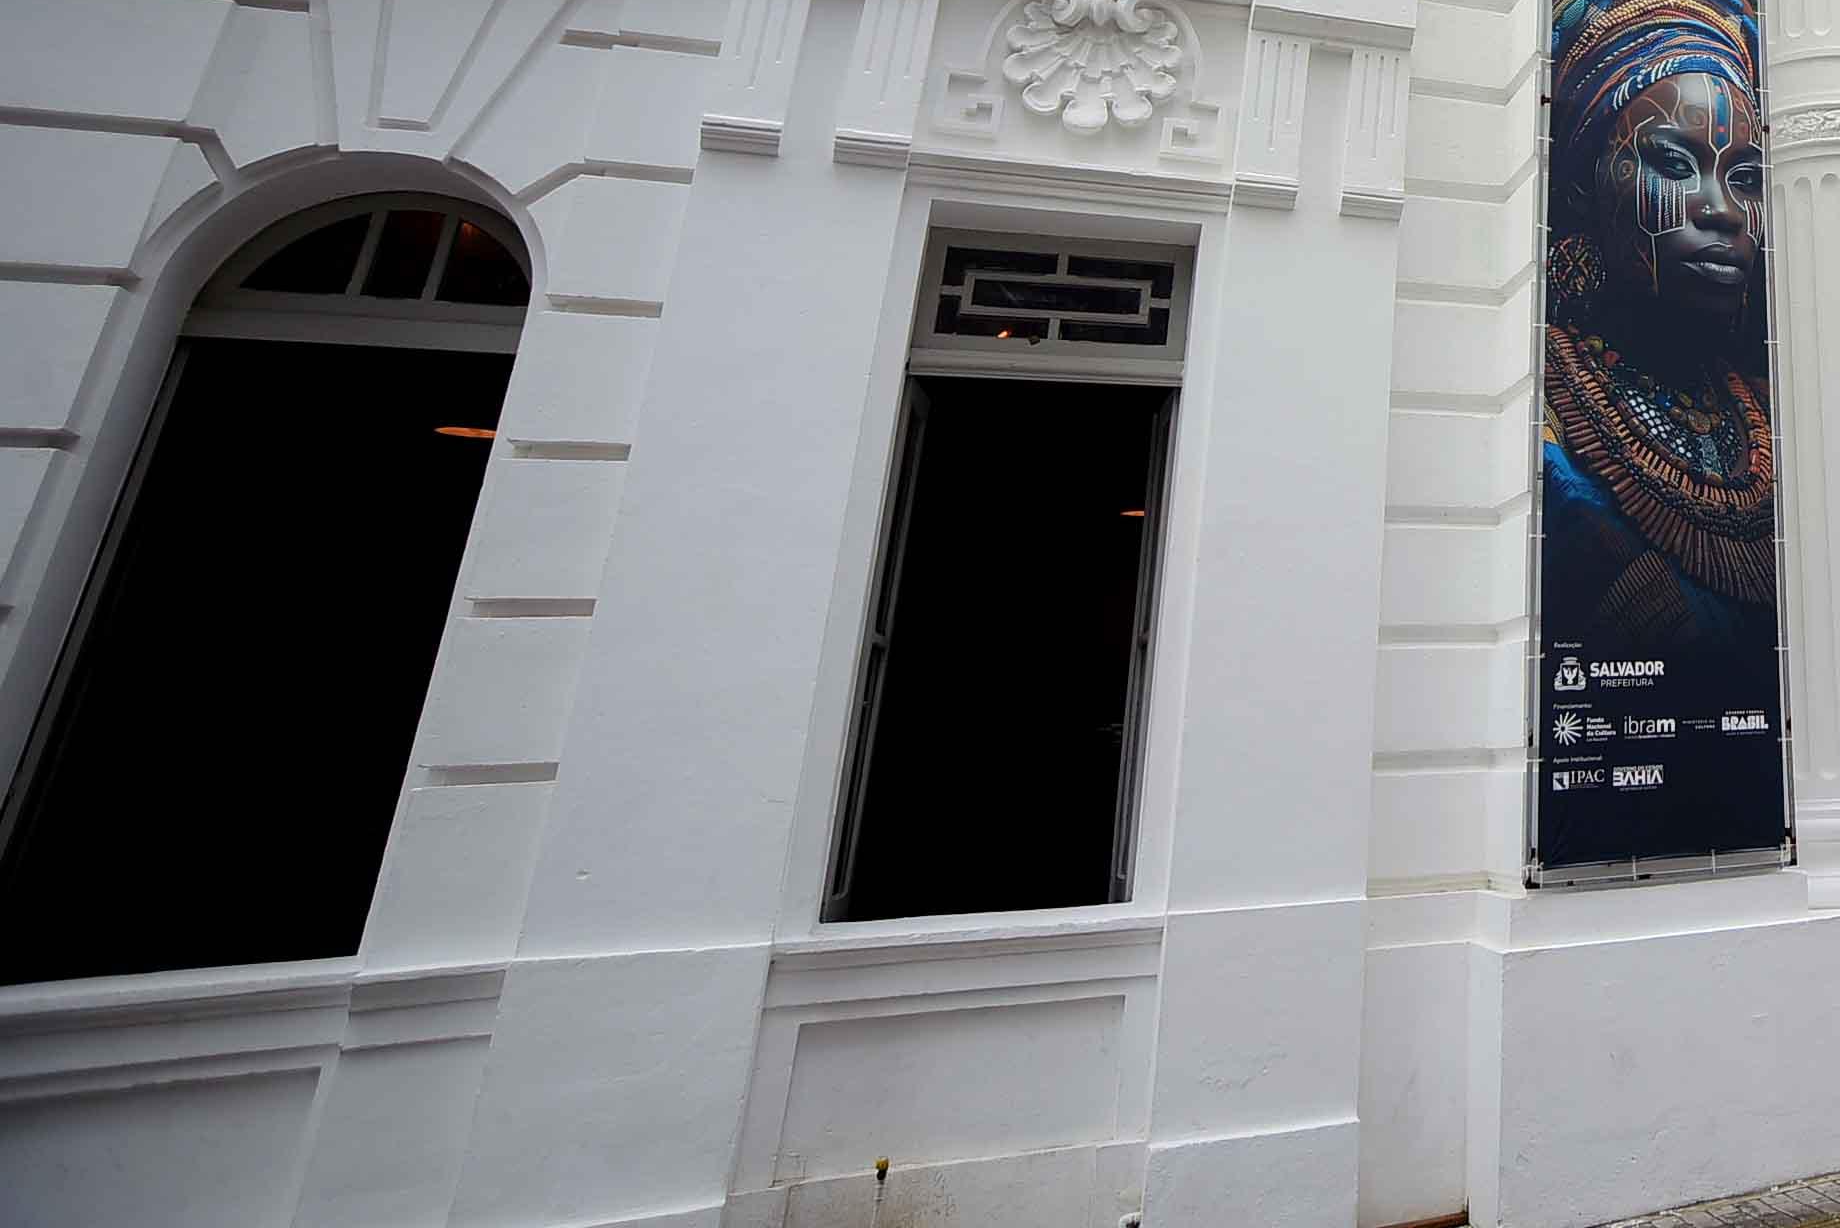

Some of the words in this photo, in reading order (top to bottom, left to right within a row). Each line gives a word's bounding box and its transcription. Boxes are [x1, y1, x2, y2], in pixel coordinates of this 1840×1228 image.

[1589, 660, 1665, 677] SALVADOR
[1600, 678, 1654, 688] PREFEITURA
[1624, 715, 1676, 735] ibram
[1571, 768, 1605, 784] IPAC
[1612, 770, 1664, 787] BAHIA
